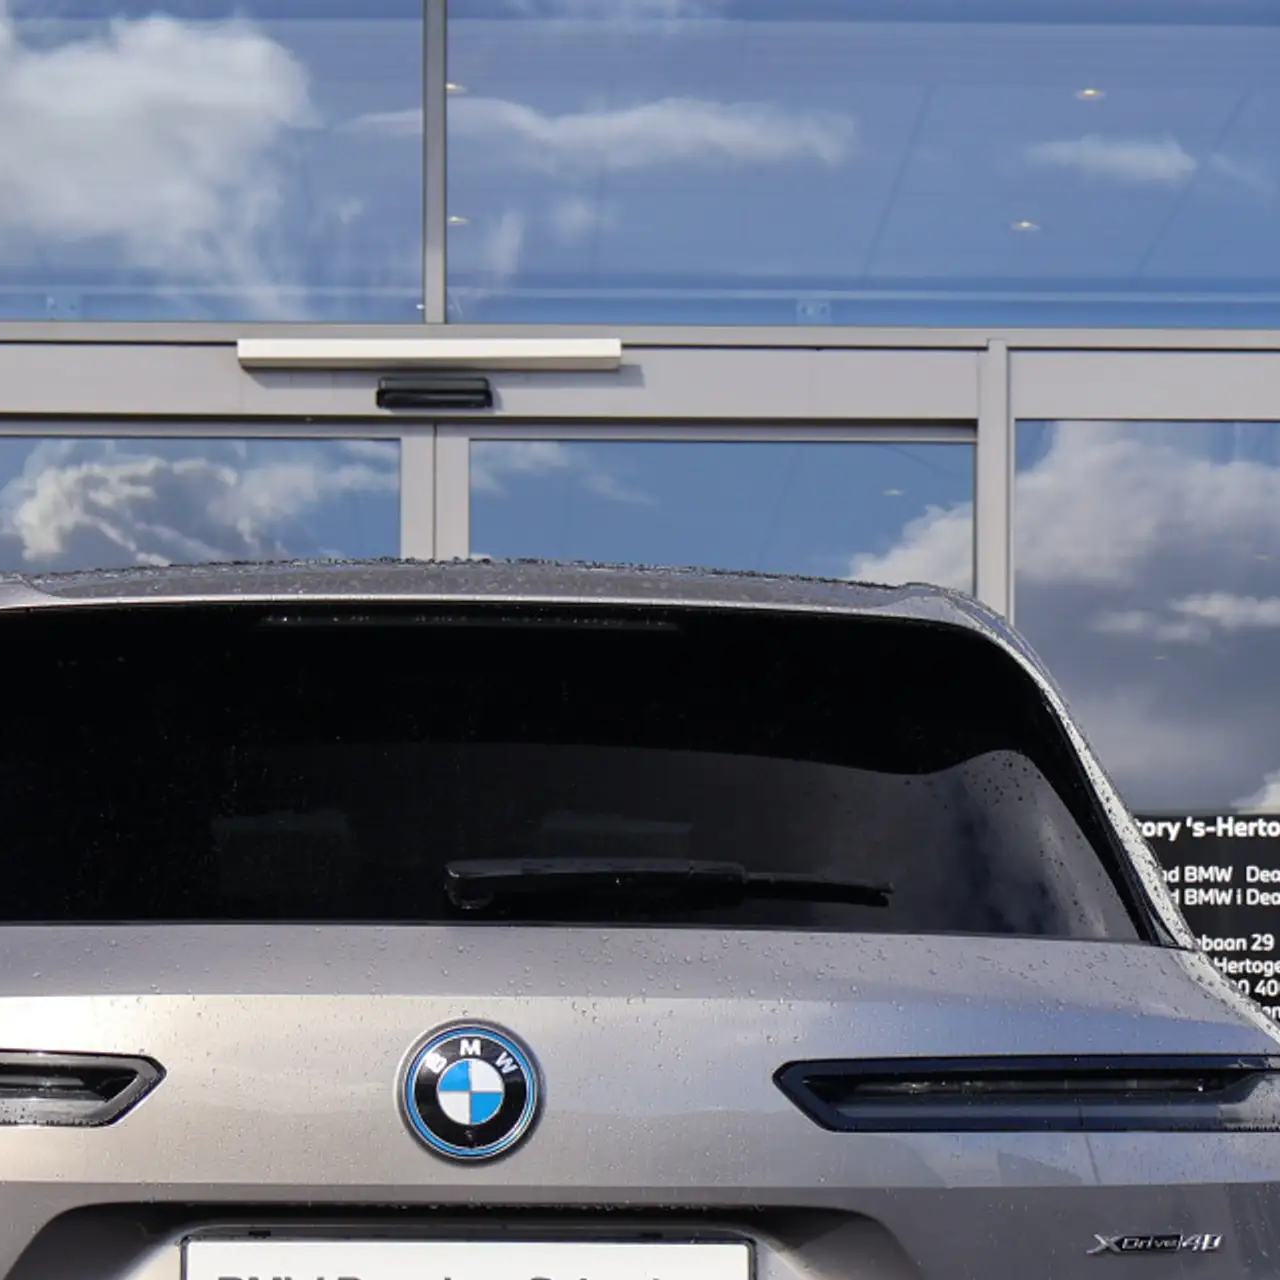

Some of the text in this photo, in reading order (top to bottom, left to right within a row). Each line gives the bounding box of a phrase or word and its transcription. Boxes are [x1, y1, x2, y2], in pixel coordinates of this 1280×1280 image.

[1184, 866, 1234, 883] BMW
[1184, 888, 1233, 906] BMW
[1236, 887, 1242, 905] i
[1250, 933, 1275, 951] 29
[423, 1038, 518, 1074] BMW
